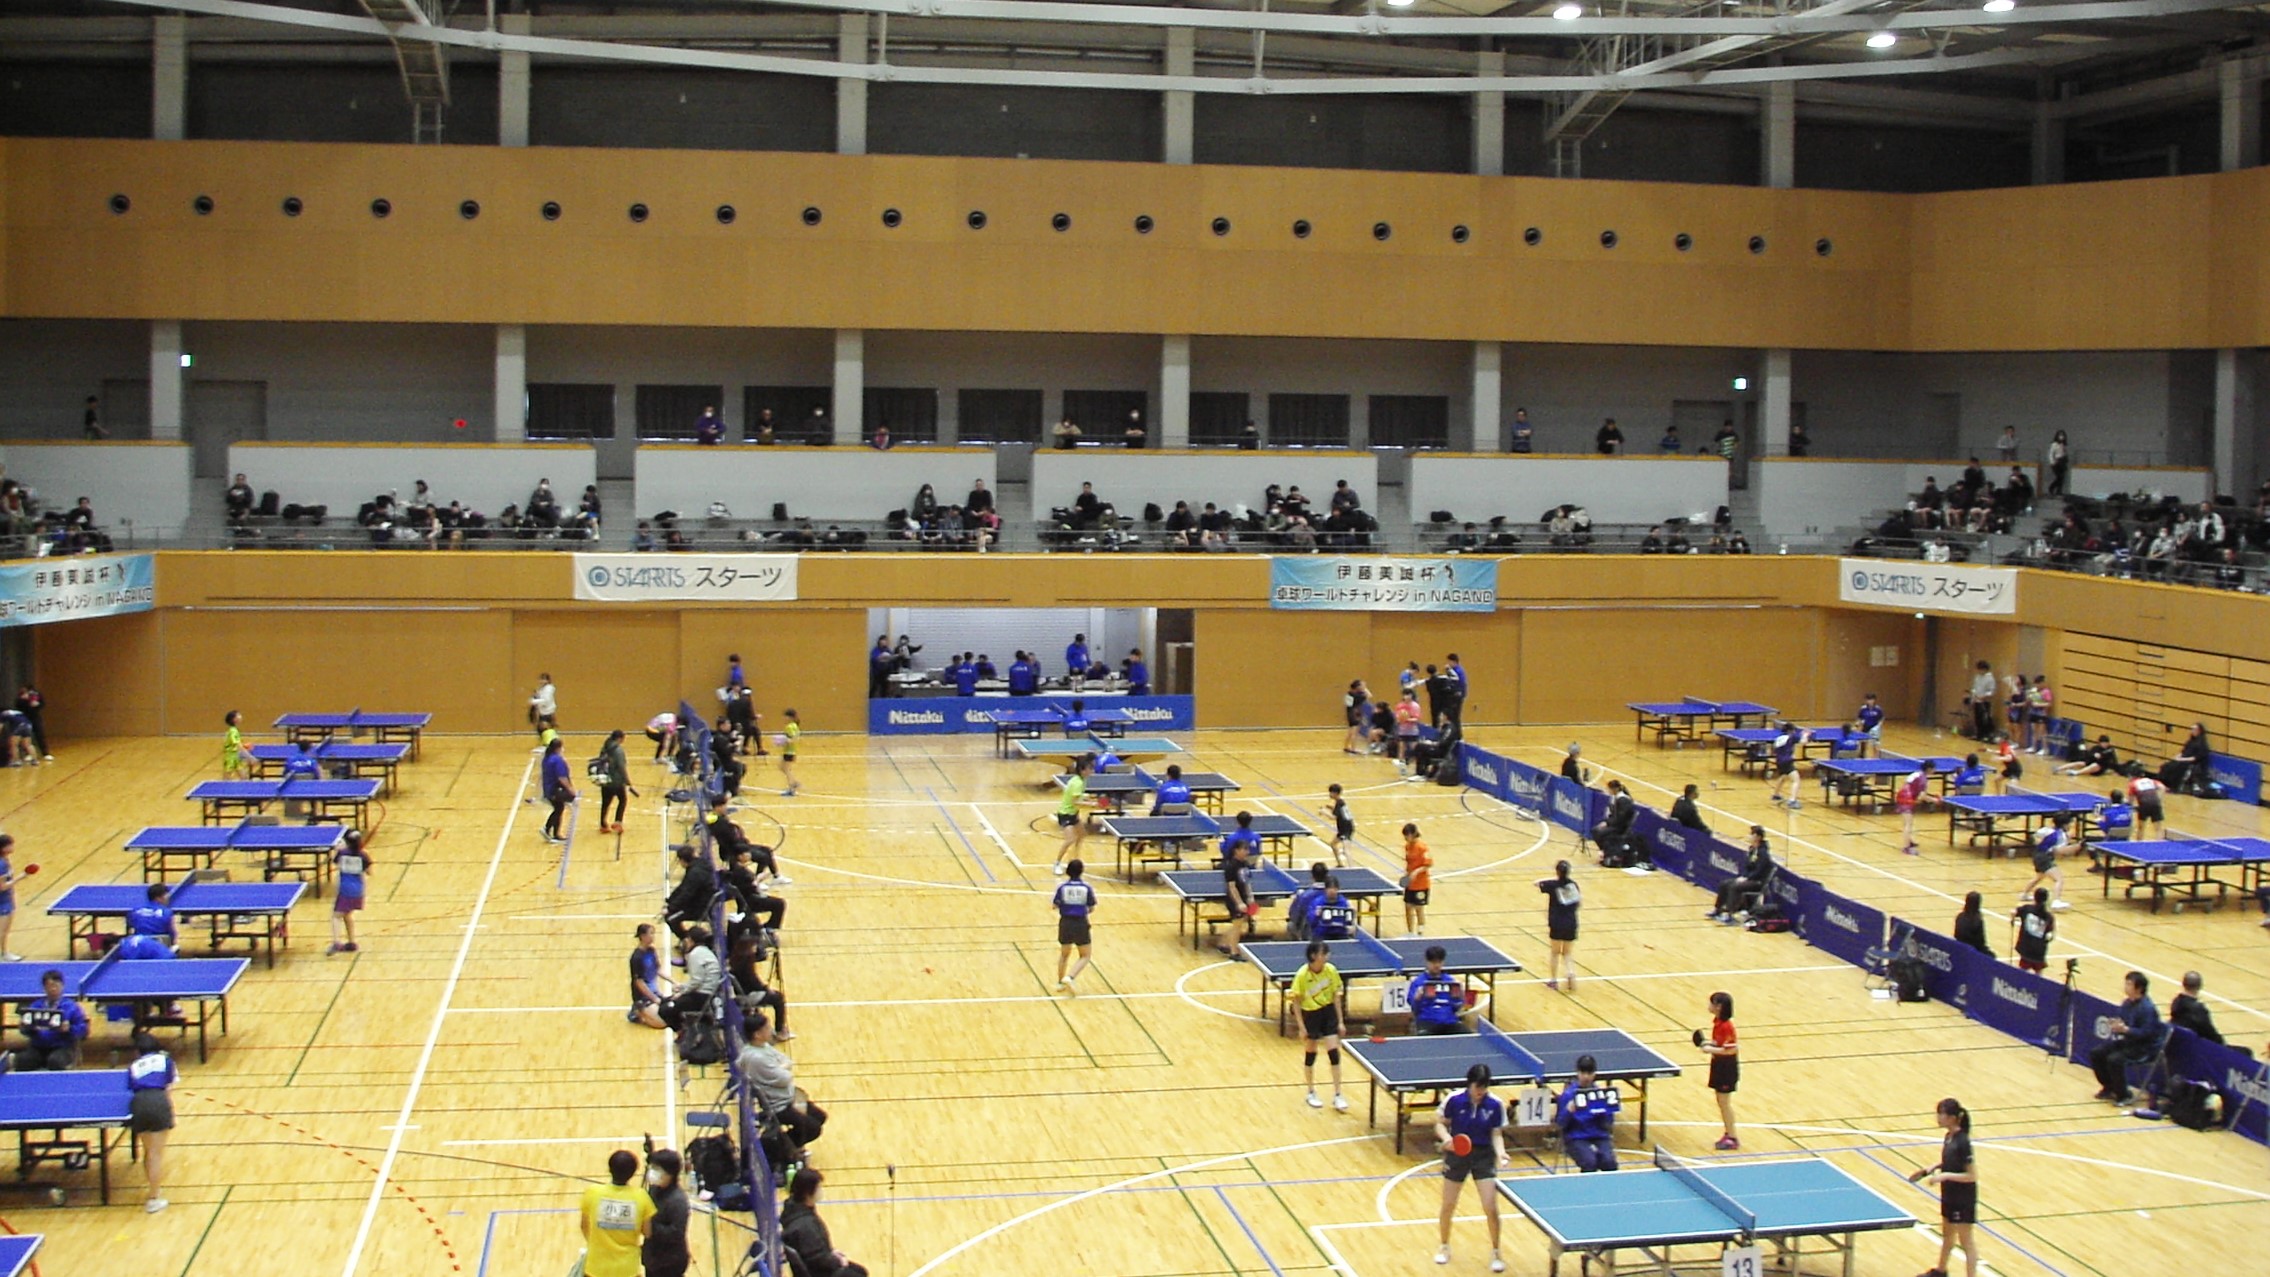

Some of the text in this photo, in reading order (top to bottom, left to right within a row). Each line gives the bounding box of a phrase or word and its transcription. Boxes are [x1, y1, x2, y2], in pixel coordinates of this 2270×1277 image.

[614, 567, 782, 588] STARTS スターツ
[1871, 573, 2004, 601] STARTS スターツ
[1414, 588, 1426, 602] in
[1389, 988, 1405, 1008] 15
[1527, 1097, 1543, 1120] 14
[1732, 1257, 1753, 1277] 13
